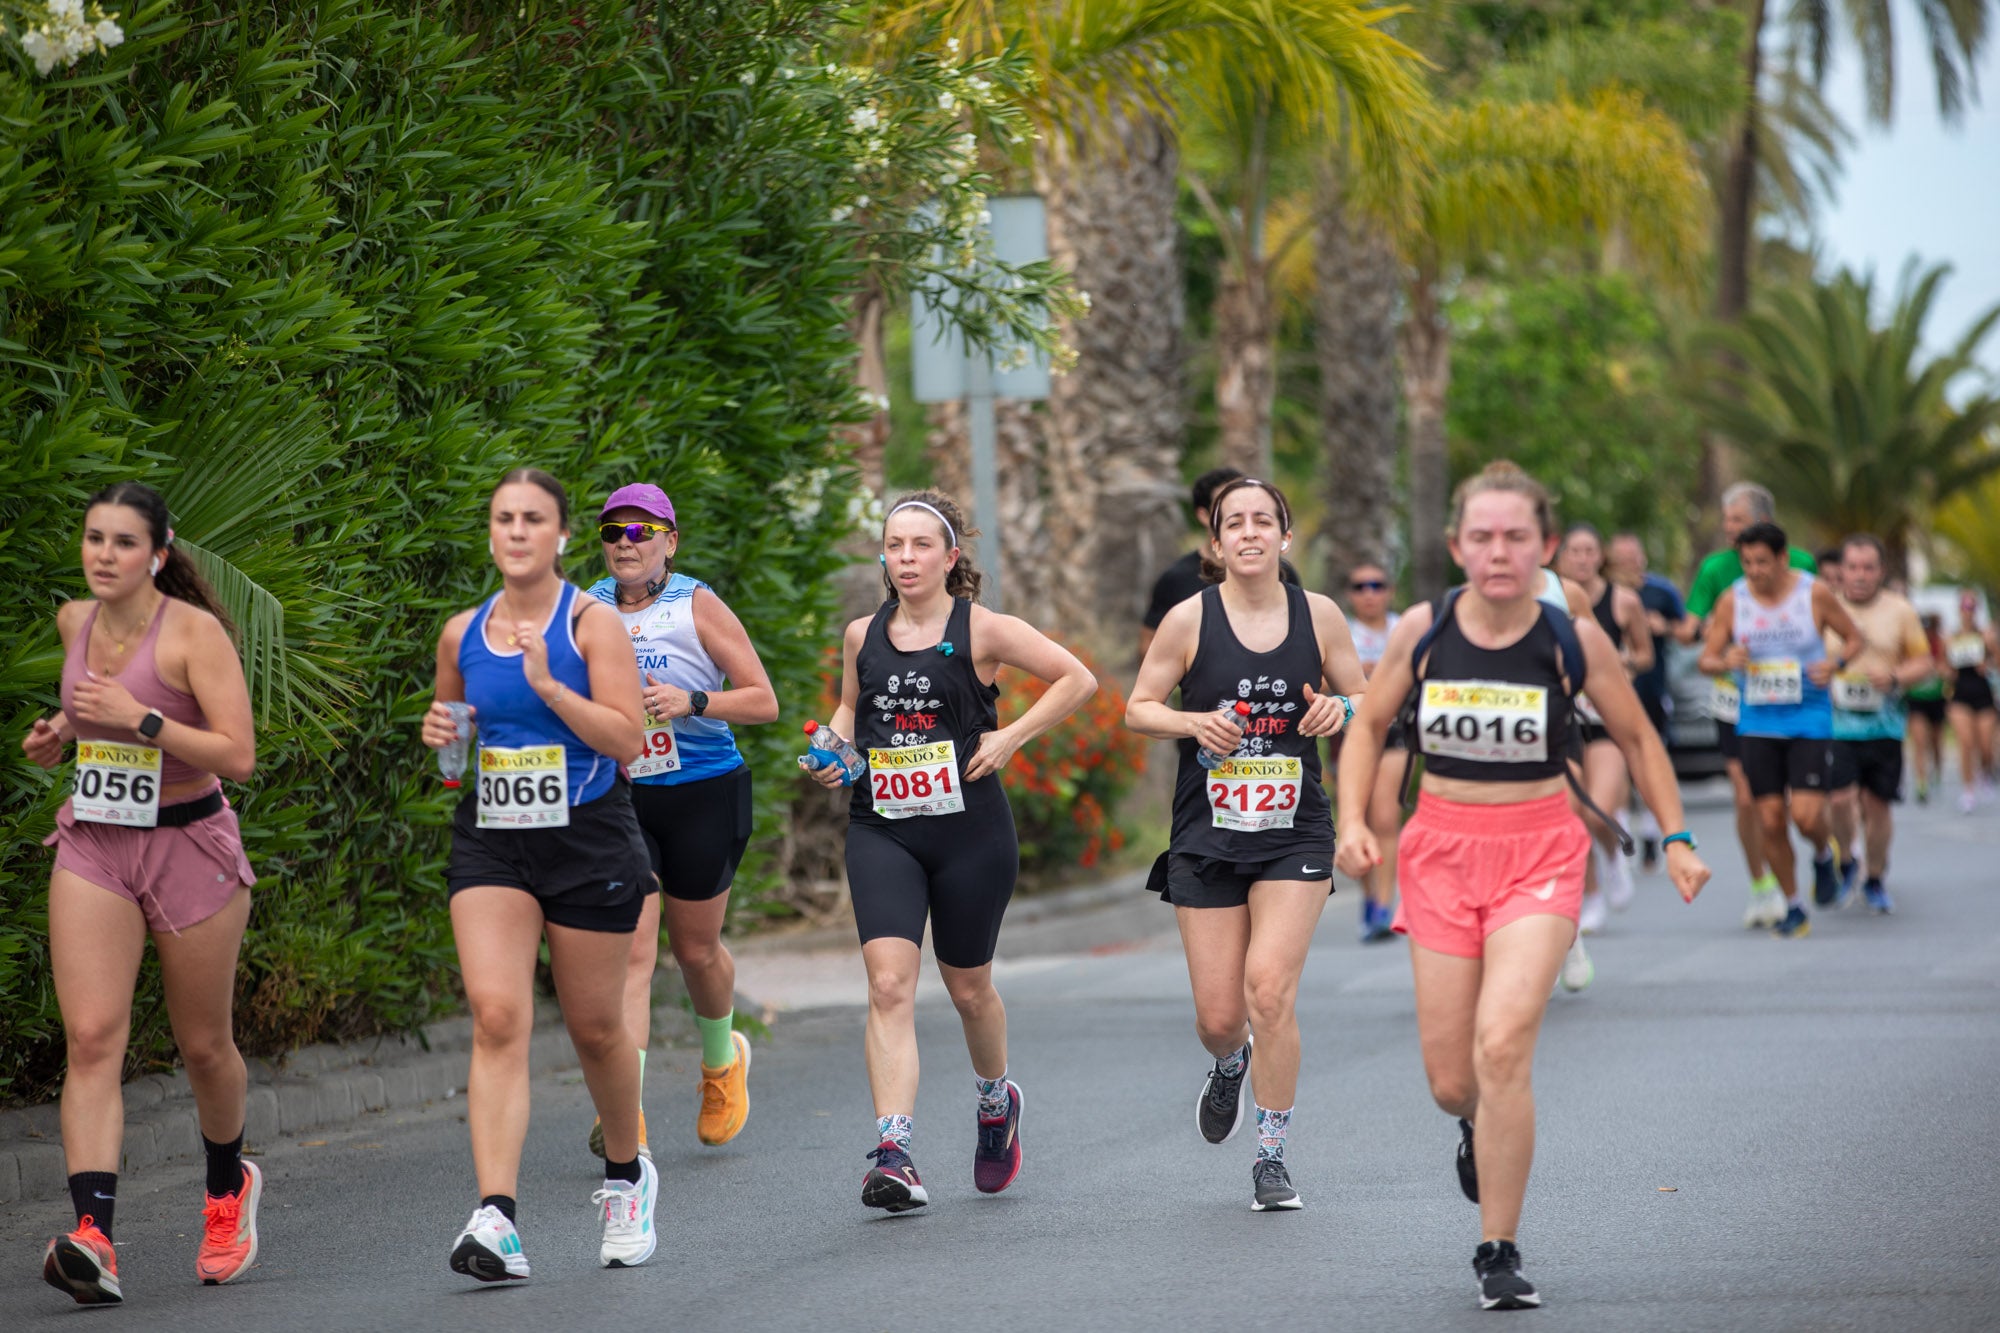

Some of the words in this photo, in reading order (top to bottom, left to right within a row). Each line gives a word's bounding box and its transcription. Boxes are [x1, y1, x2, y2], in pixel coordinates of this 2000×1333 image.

[637, 655, 668, 669] ENA
[1255, 683, 1270, 691] ipso
[895, 712, 938, 732] MUERE
[1426, 714, 1539, 744] 4016
[643, 732, 672, 759] 49
[878, 751, 890, 764] 38
[1233, 765, 1283, 776] FONDO
[482, 775, 562, 807] 3066
[873, 766, 952, 800] 2081
[1210, 783, 1296, 812] 2123
